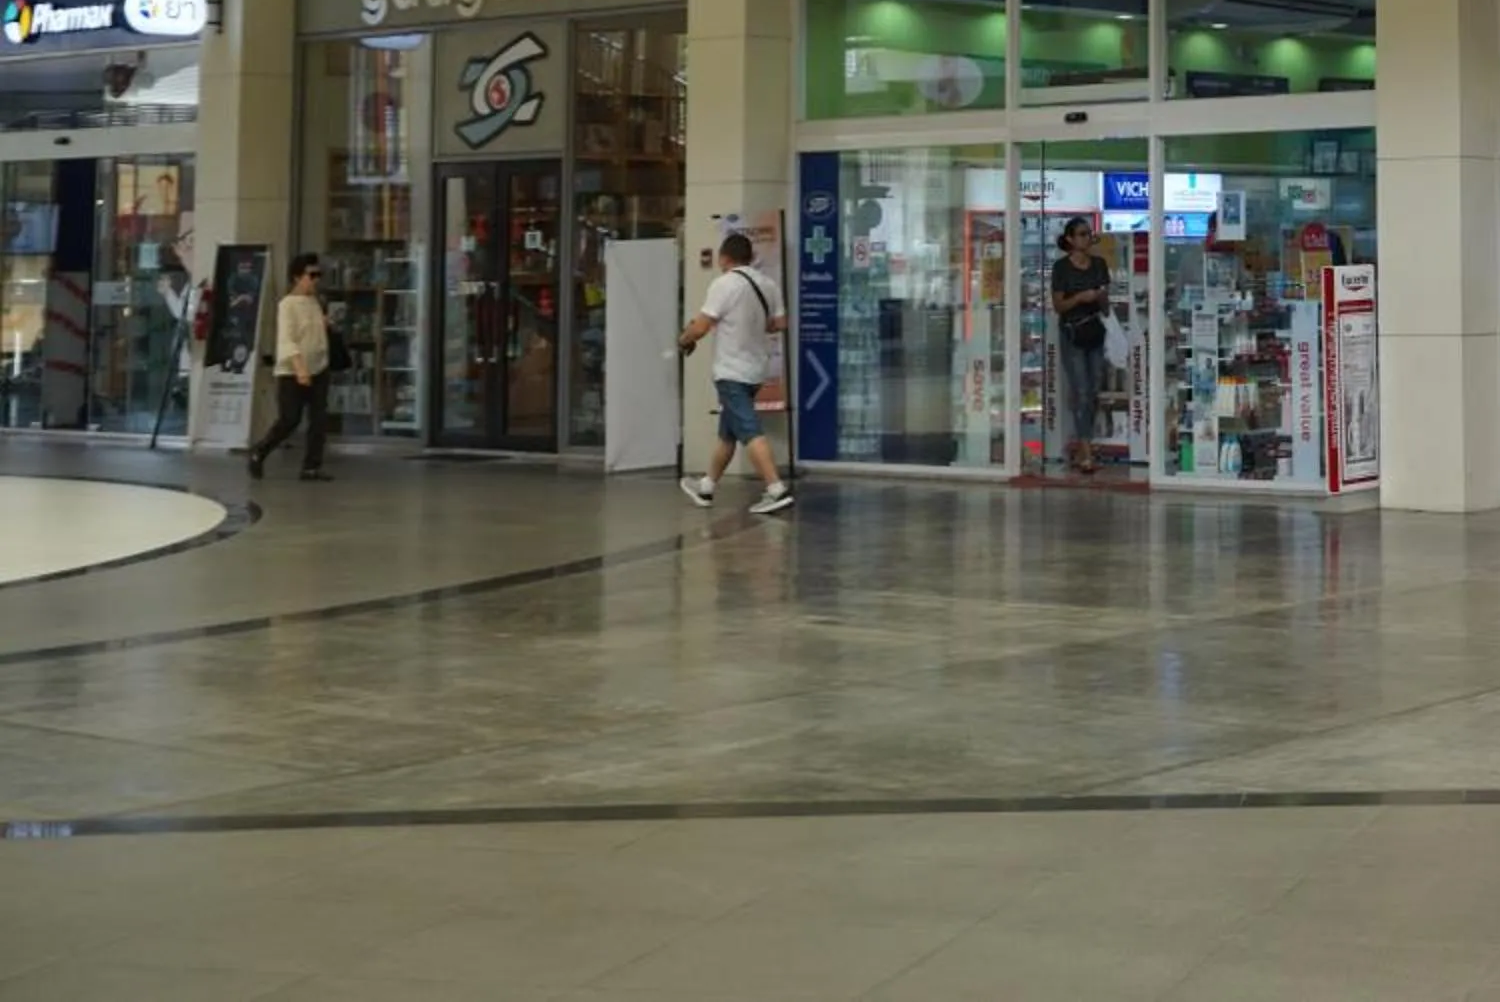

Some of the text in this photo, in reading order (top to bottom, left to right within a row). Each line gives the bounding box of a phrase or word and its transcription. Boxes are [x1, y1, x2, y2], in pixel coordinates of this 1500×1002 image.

[1117, 181, 1149, 197] VICH
[1132, 345, 1144, 435] special offer
[1297, 341, 1311, 442] great value
